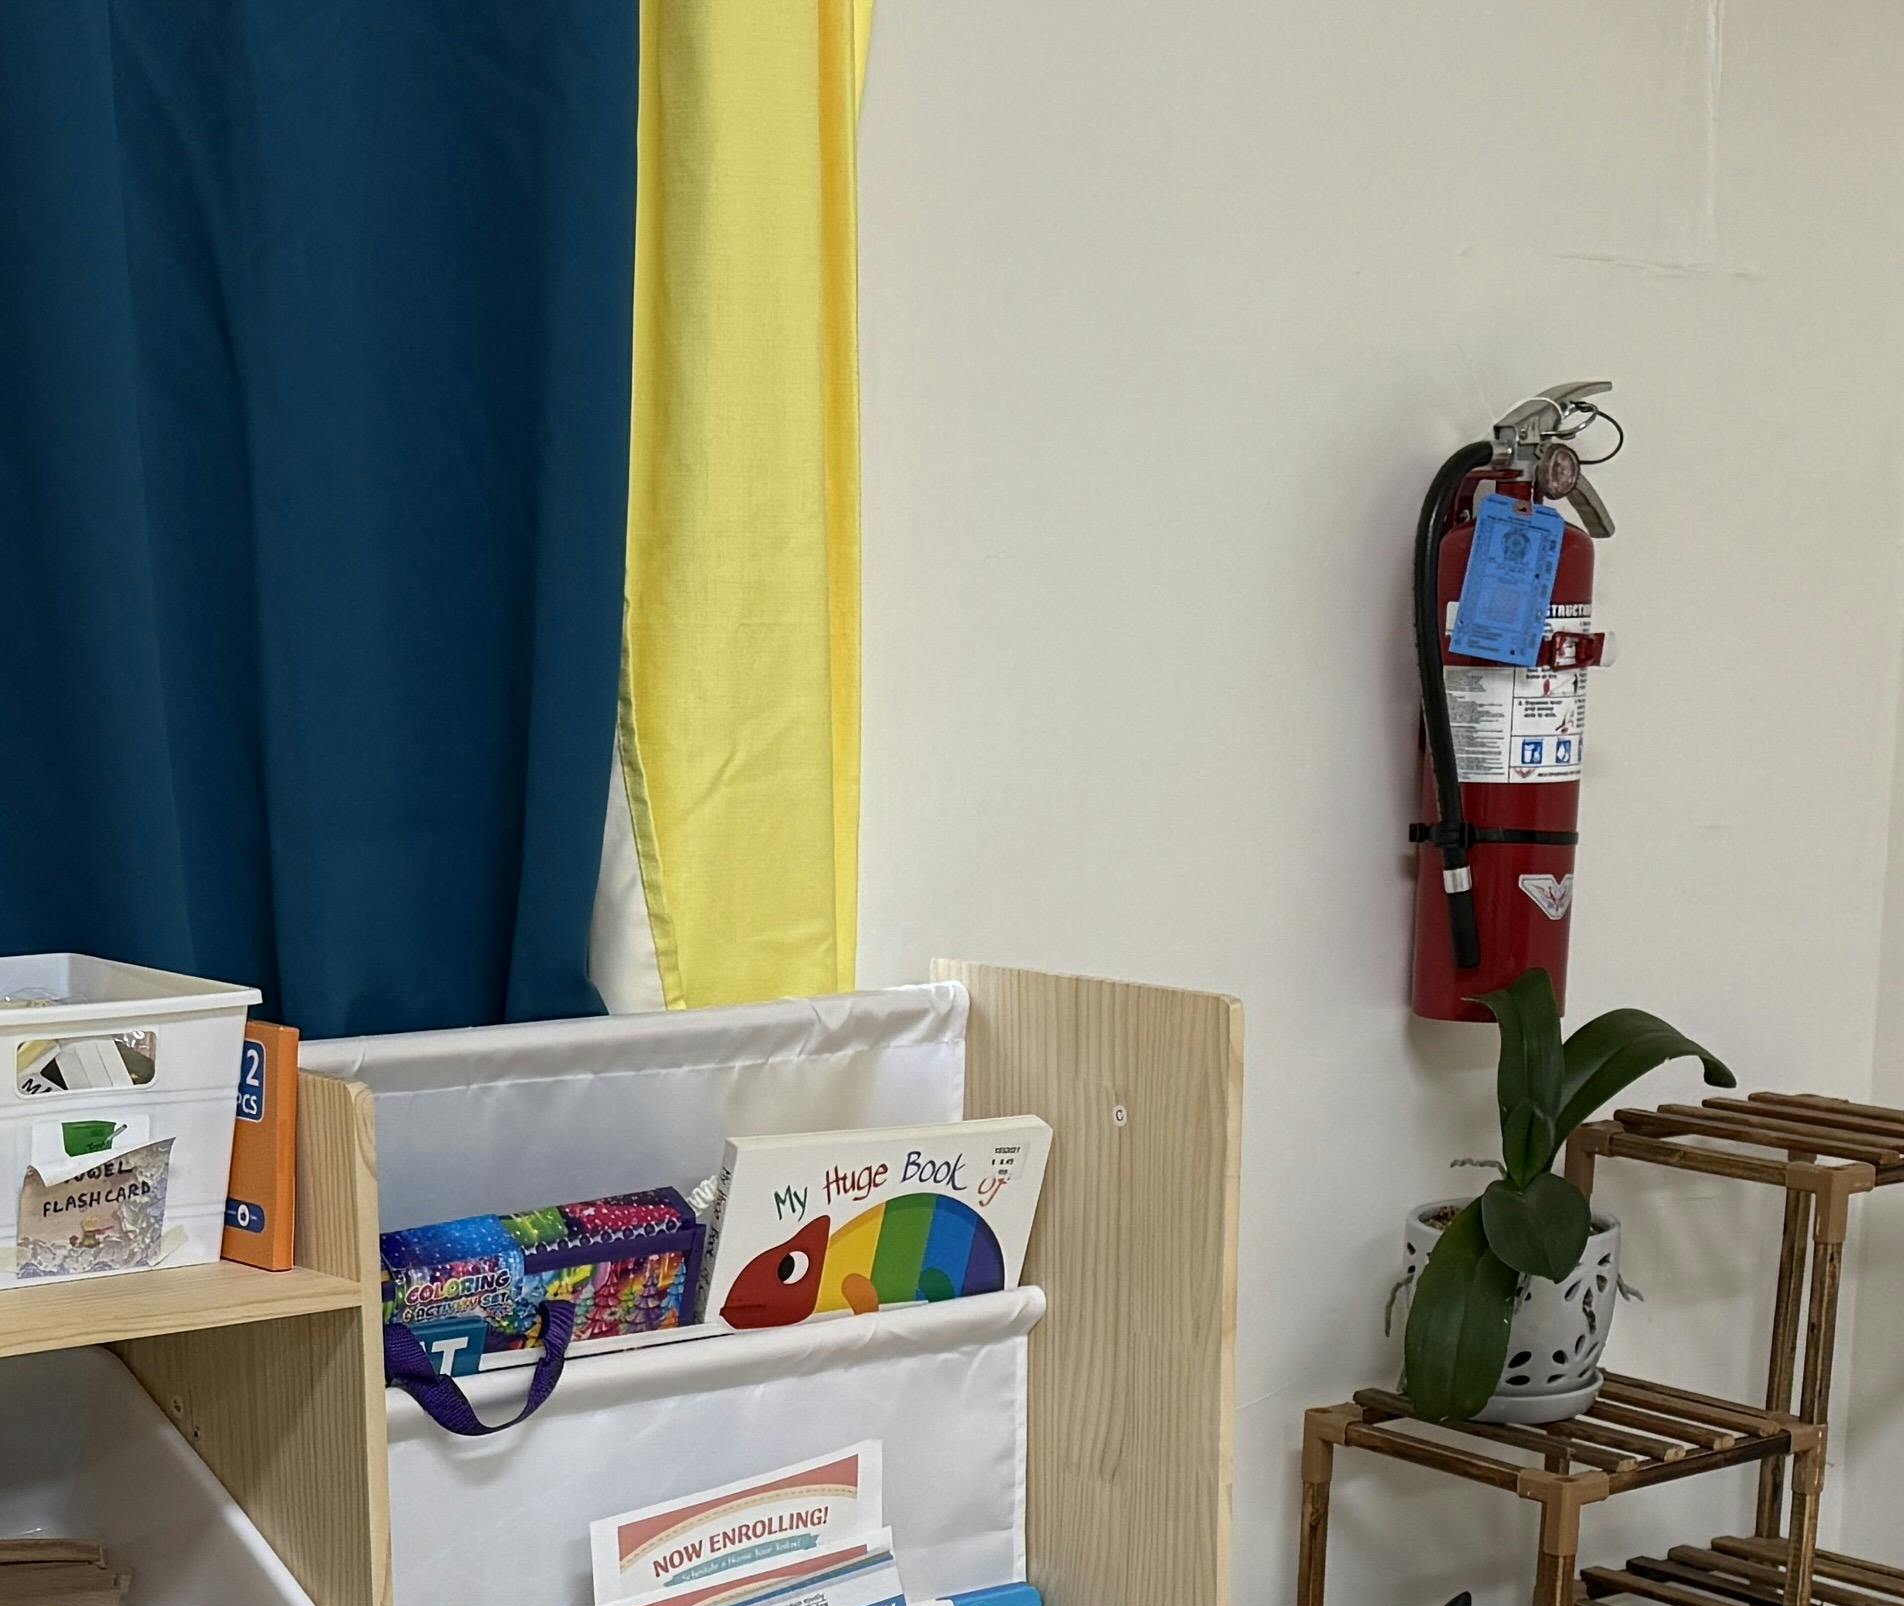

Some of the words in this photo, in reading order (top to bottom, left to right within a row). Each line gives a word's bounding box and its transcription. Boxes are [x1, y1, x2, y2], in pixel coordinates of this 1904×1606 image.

[773, 1184, 809, 1223] My
[822, 1161, 889, 1205] Huge
[900, 1151, 968, 1192] Book
[405, 1269, 512, 1305] COLORING
[652, 1540, 704, 1578] NOW
[708, 1506, 829, 1554] ENROLLING!
